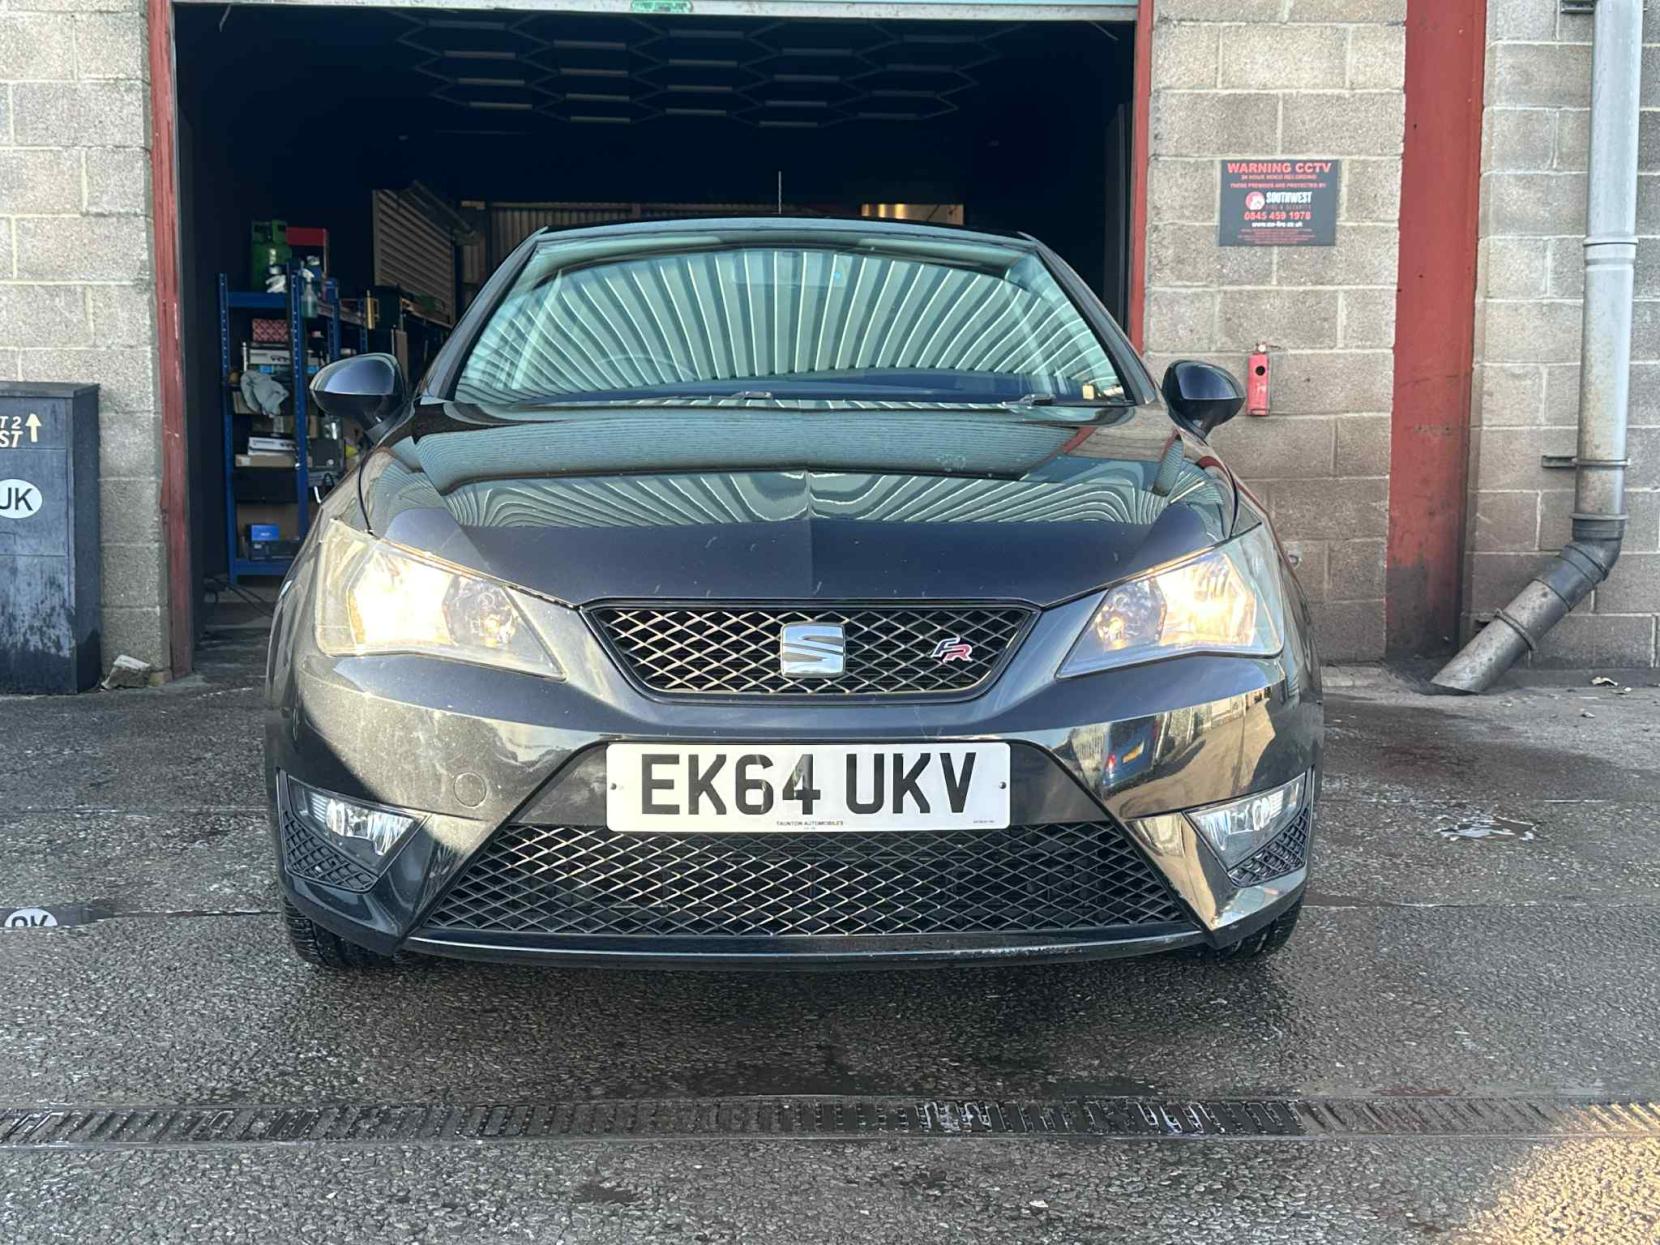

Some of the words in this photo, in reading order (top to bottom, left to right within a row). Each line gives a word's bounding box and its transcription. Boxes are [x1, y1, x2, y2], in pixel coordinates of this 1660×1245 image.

[1227, 163, 1291, 173] WARNING
[1295, 163, 1332, 173] CCTV
[1266, 191, 1312, 204] SOUTHWEST
[1244, 211, 1267, 220] 0845
[1269, 211, 1286, 220] 459
[11, 416, 22, 430] 2
[641, 753, 821, 816] EK64
[845, 752, 977, 814] UKV
